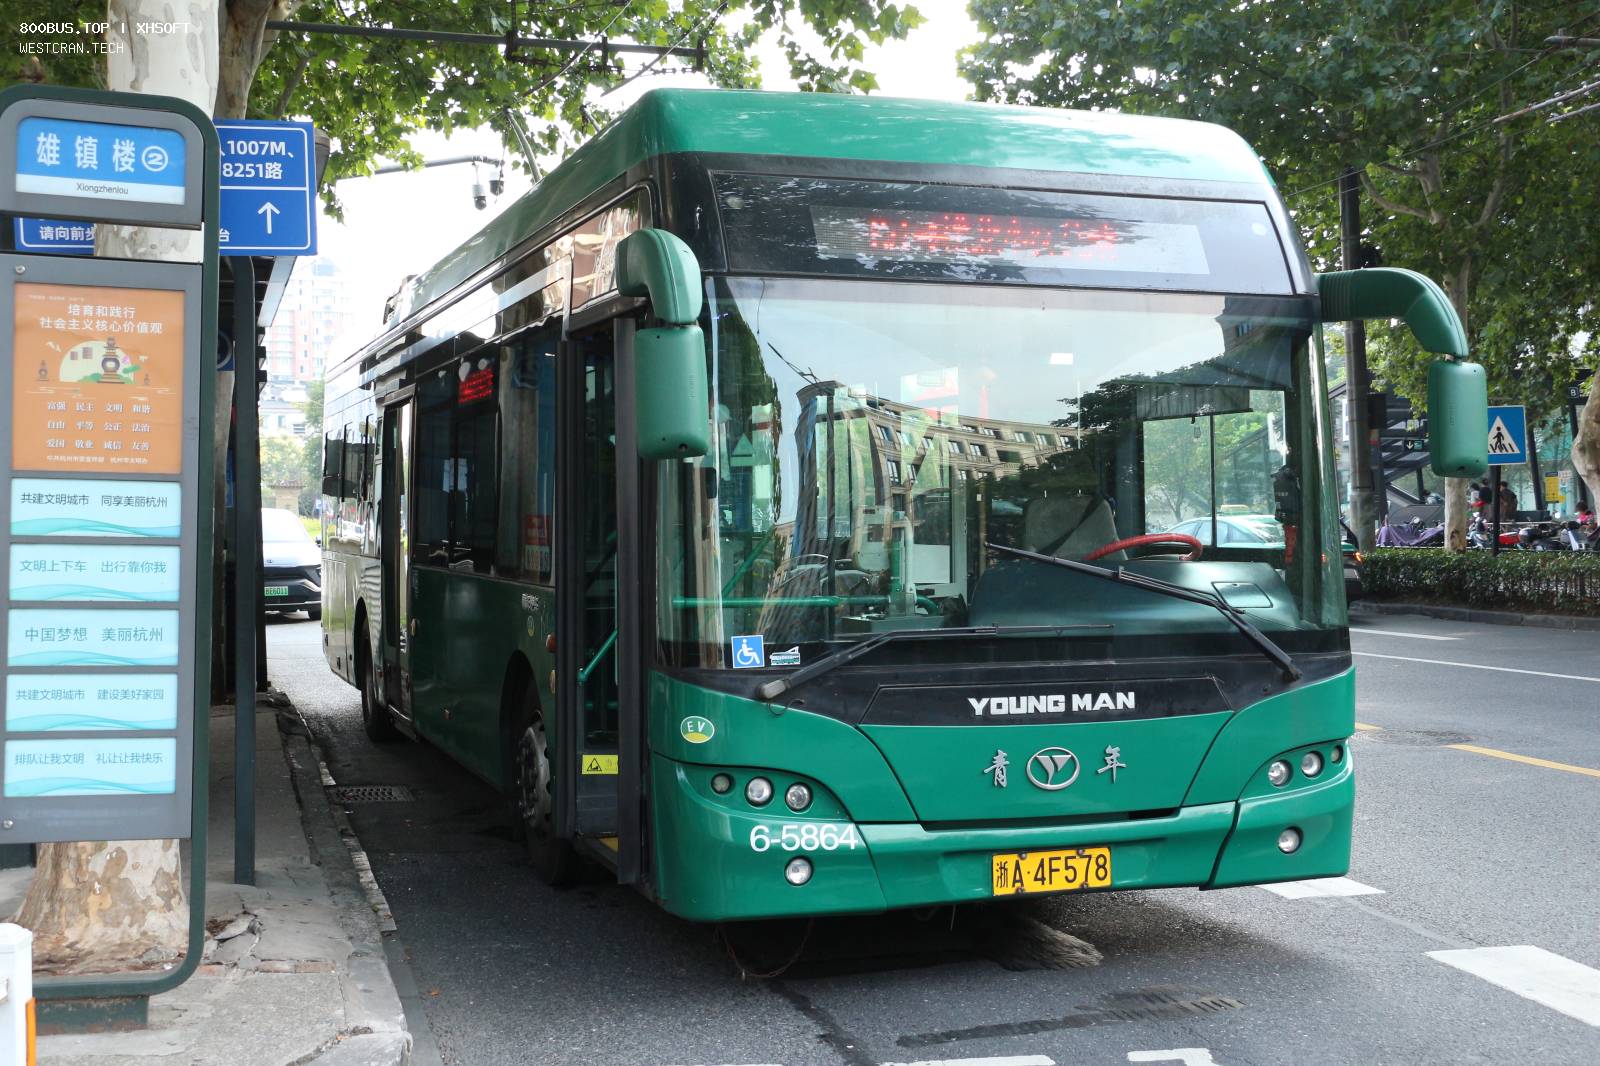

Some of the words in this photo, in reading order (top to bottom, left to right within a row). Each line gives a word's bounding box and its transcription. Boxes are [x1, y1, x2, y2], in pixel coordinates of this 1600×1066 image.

[76, 182, 129, 195] Xiongzhenlou
[68, 304, 136, 318] 培育和践行
[40, 317, 162, 334] 社会主义核心价值观
[105, 404, 123, 413] 文明
[104, 423, 122, 432] 公正
[20, 493, 90, 506] 共建文明城市
[101, 495, 168, 508] 同享美丽杭州
[19, 559, 87, 574] 文明上下车
[101, 560, 167, 574] 出行靠你我
[24, 627, 88, 643] 中国梦想
[101, 627, 164, 643] 美丽杭州
[15, 689, 86, 702] 共建文明城市
[97, 688, 165, 701] 建设美好家园
[968, 697, 1065, 715] YOUNG
[1071, 692, 1136, 711] MAN
[687, 720, 707, 733] EV
[15, 753, 85, 766] 排队让我文明
[95, 752, 164, 766] 礼让让我快乐
[984, 750, 1010, 788] 青
[1096, 745, 1127, 784] 年
[749, 824, 858, 852] 6-5864
